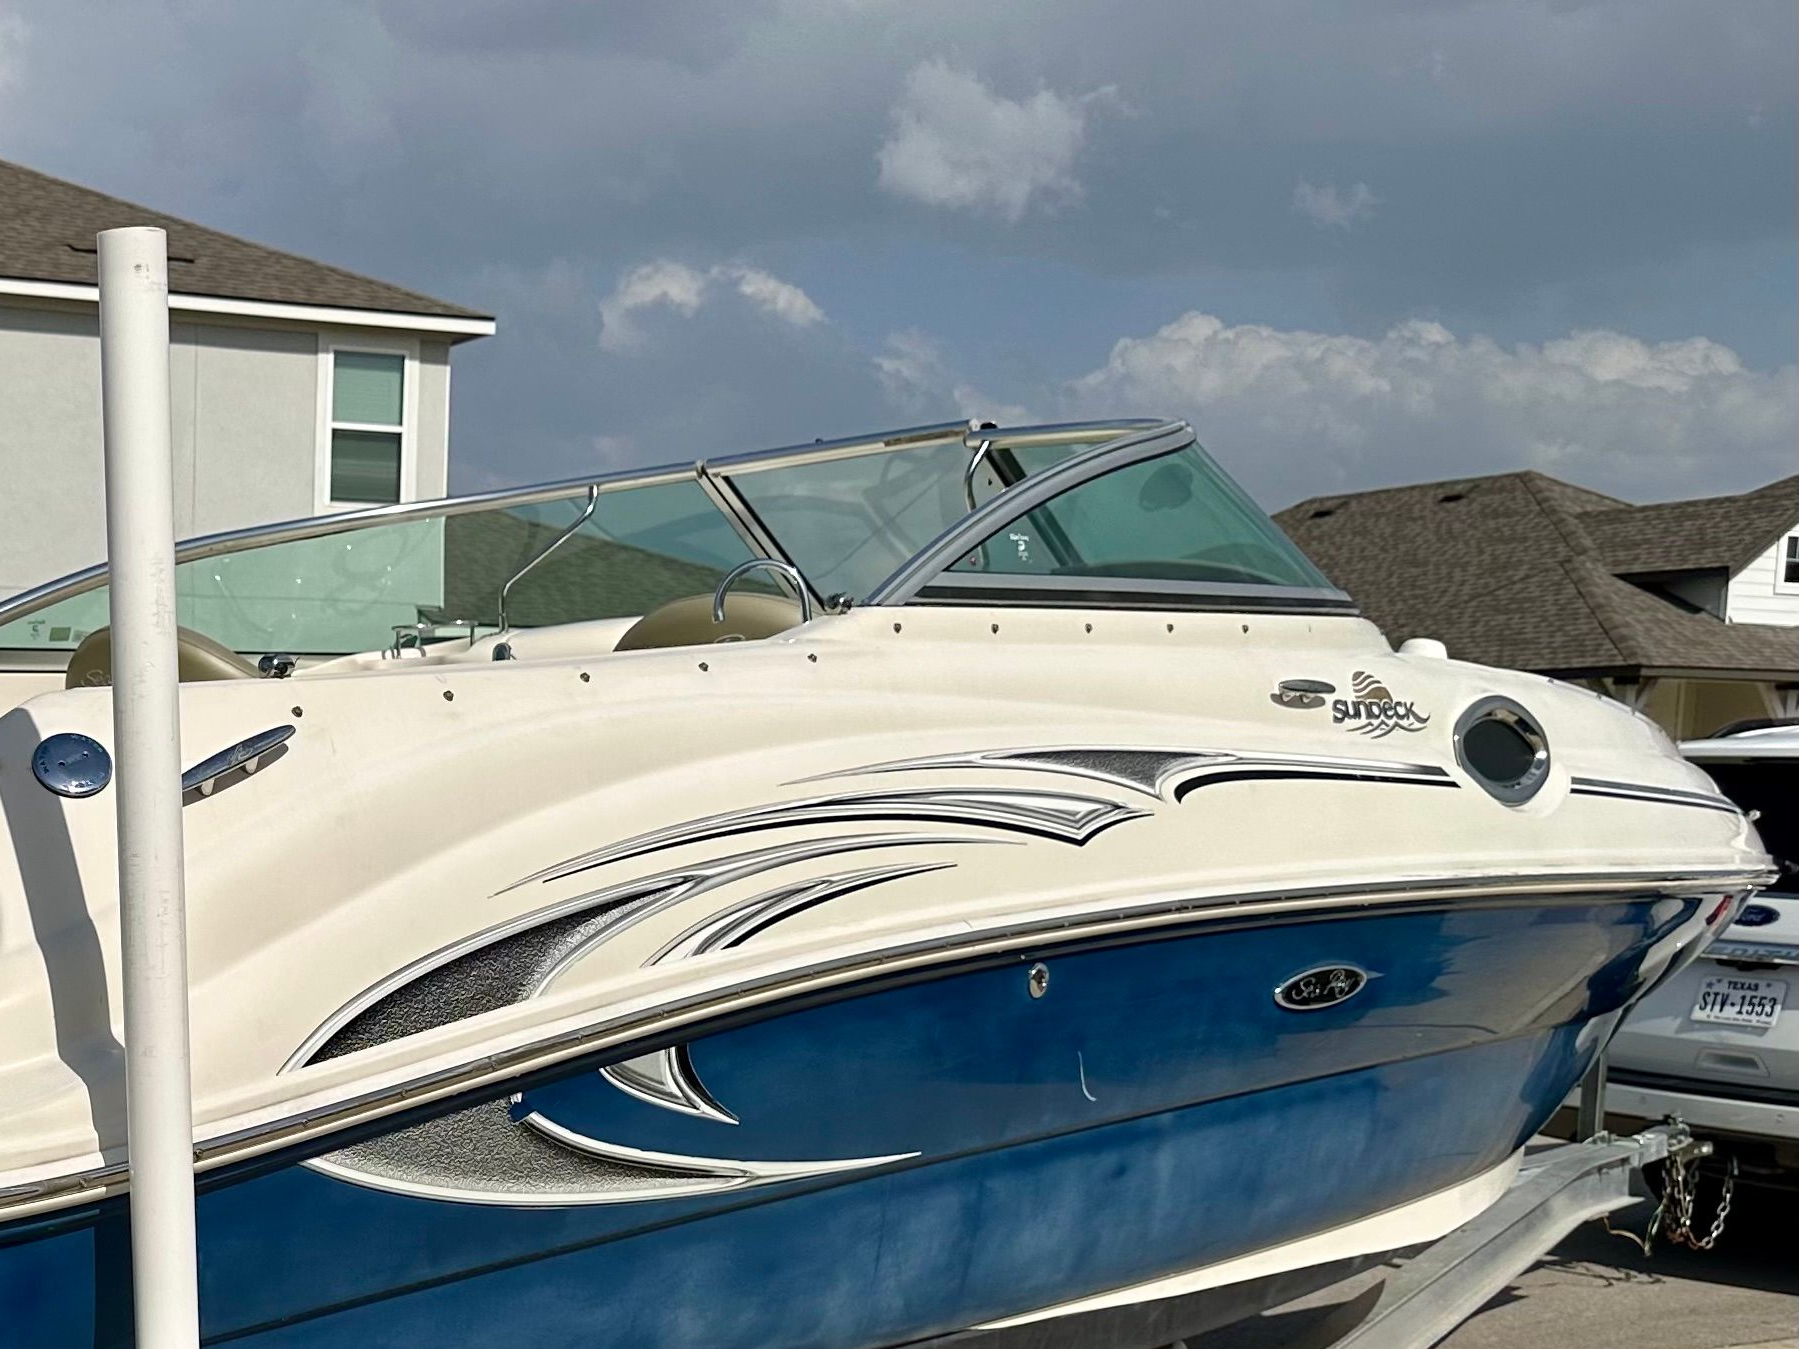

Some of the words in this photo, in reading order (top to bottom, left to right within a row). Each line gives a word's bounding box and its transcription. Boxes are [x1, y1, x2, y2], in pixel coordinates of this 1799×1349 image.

[1291, 976, 1322, 1000] Sea
[1323, 969, 1355, 999] Ray
[1727, 980, 1759, 992] TEXAS
